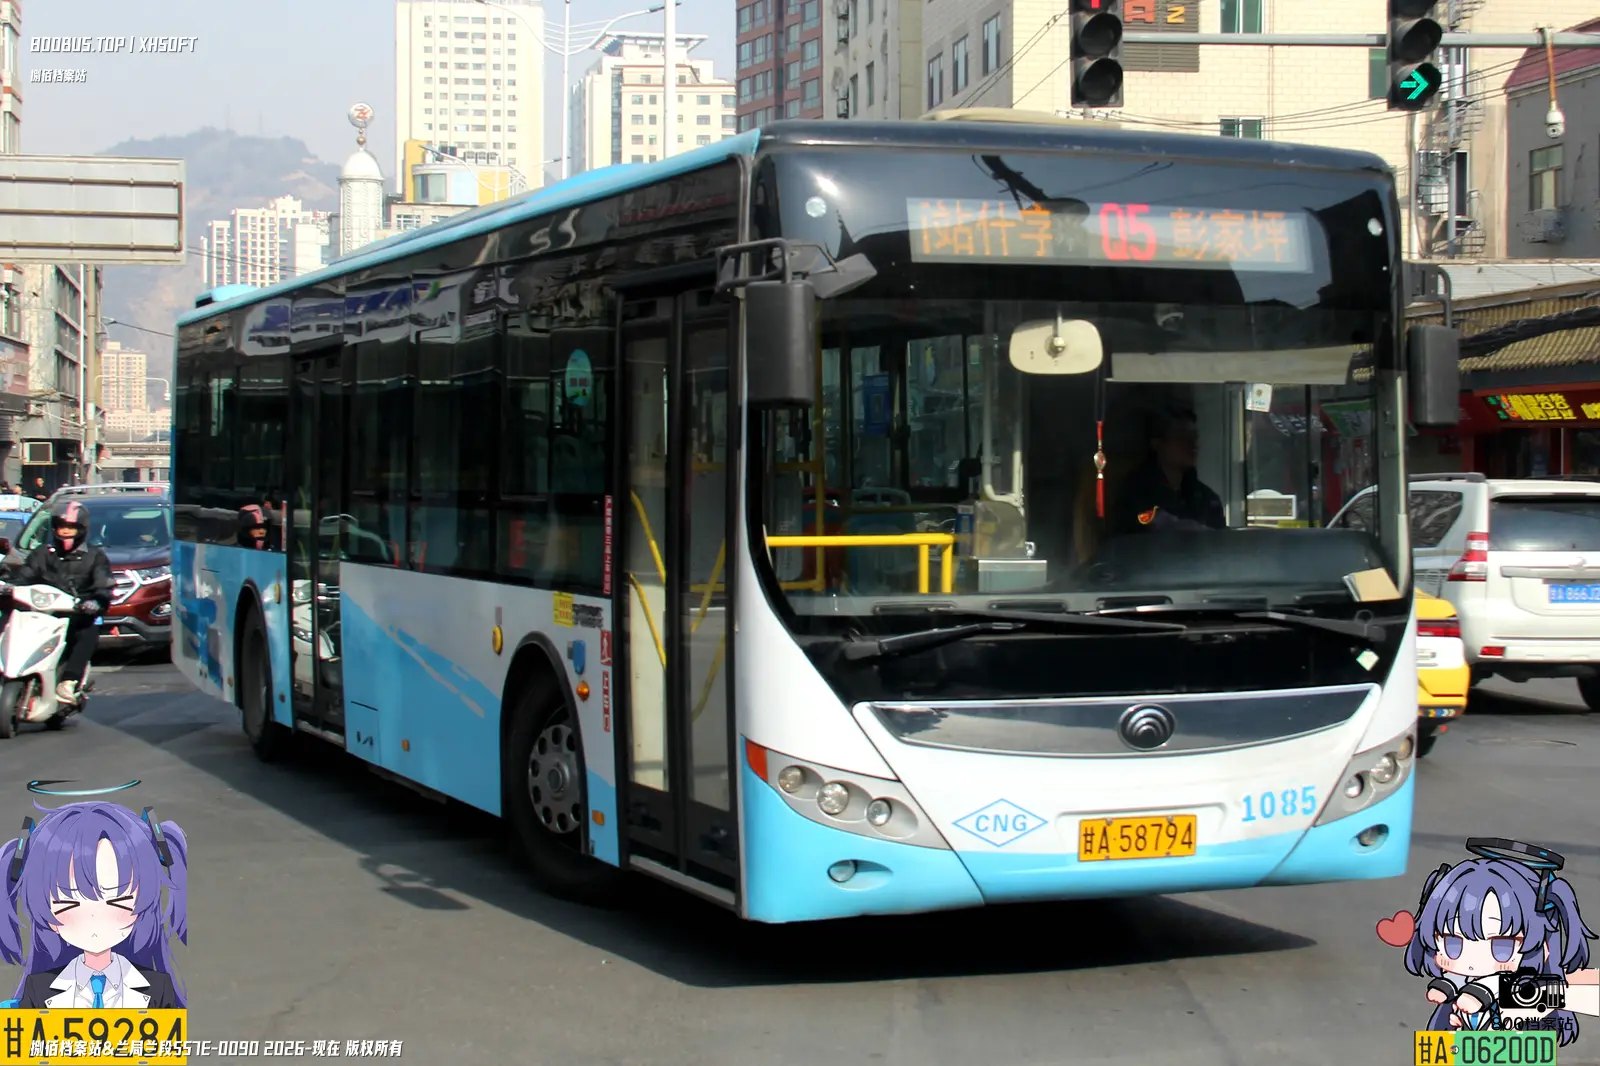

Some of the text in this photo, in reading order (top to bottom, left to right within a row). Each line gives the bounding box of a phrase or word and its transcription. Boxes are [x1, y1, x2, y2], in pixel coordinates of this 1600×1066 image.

[919, 200, 1290, 262] 站什字 Q5 彭家坪
[1241, 786, 1317, 822] 1085
[975, 814, 1028, 833] CNG
